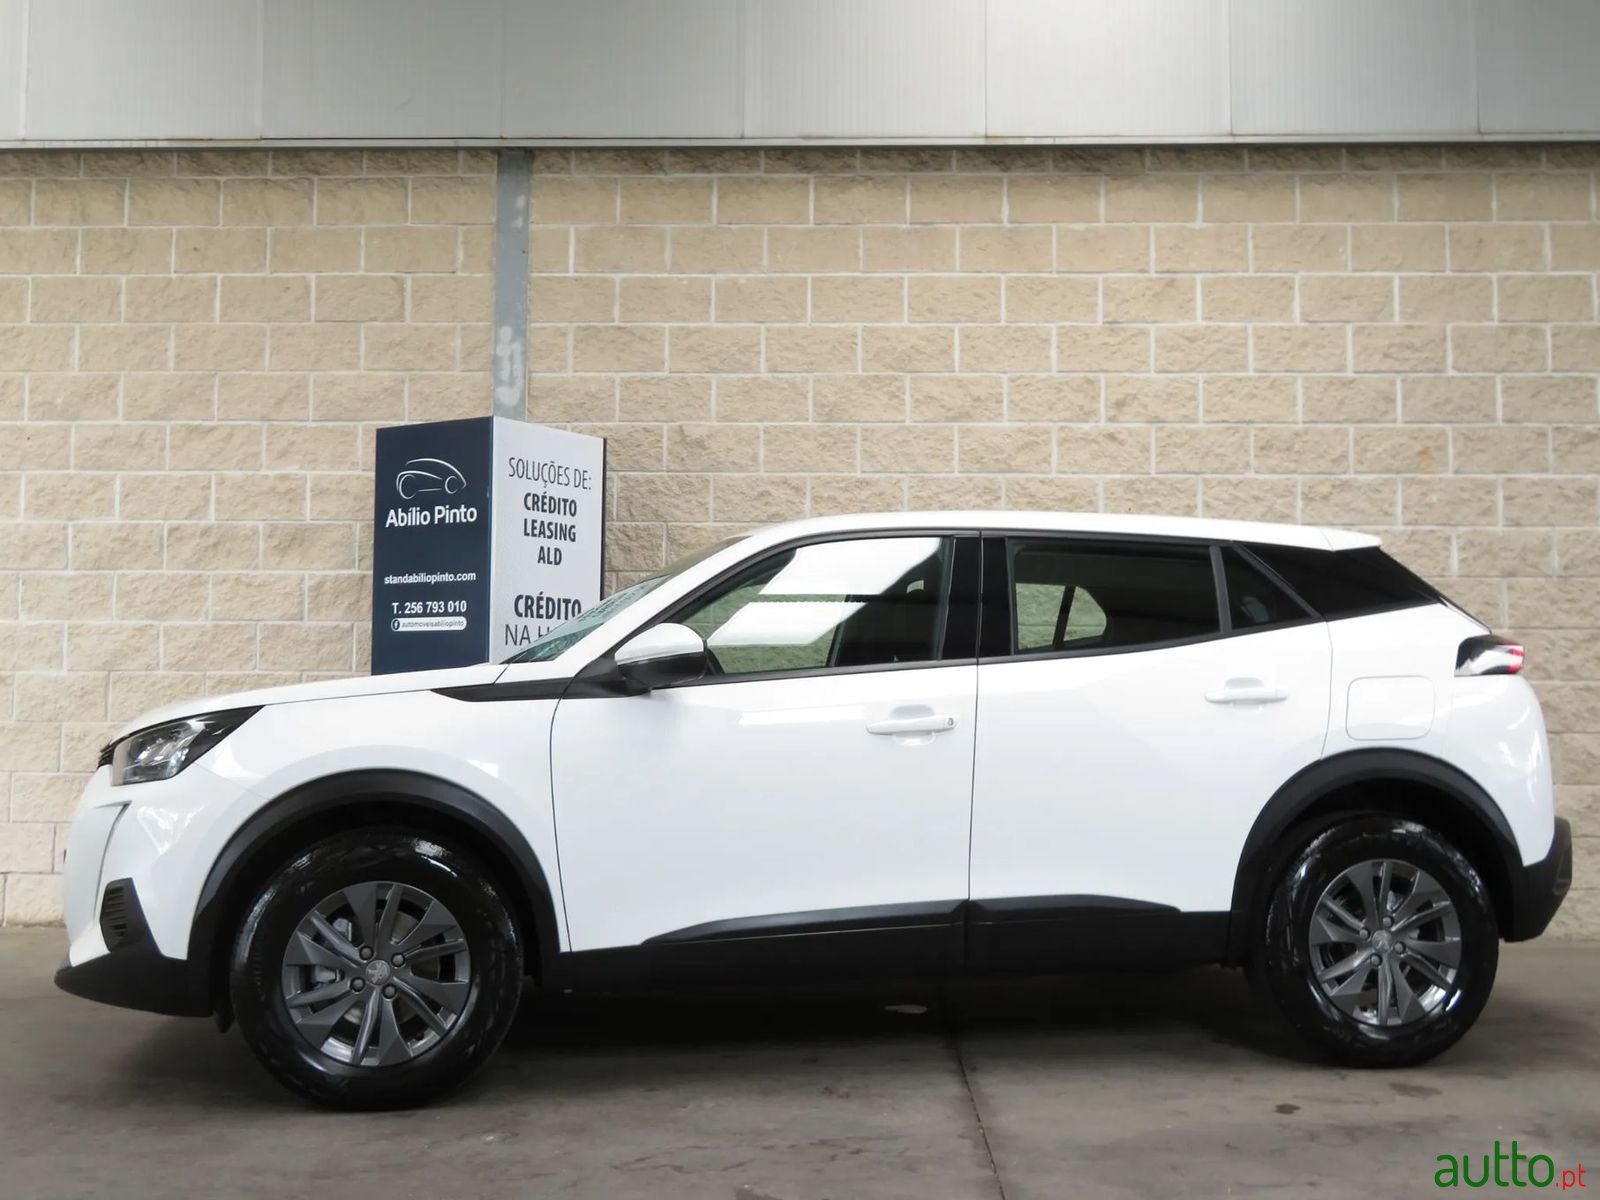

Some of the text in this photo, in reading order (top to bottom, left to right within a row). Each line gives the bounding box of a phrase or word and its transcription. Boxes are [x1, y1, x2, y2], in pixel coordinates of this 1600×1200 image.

[508, 457, 592, 490] SOLUÇÕES DE:
[385, 504, 478, 528] Abílio Pinto
[523, 491, 577, 517] CRÉDITO
[523, 518, 576, 542] LEASING
[537, 545, 562, 566] ALD
[384, 571, 477, 585] standabiliopinto.com
[391, 600, 467, 615] T. 256 793 010
[514, 591, 582, 620] CRÉDITO
[505, 623, 532, 646] NA
